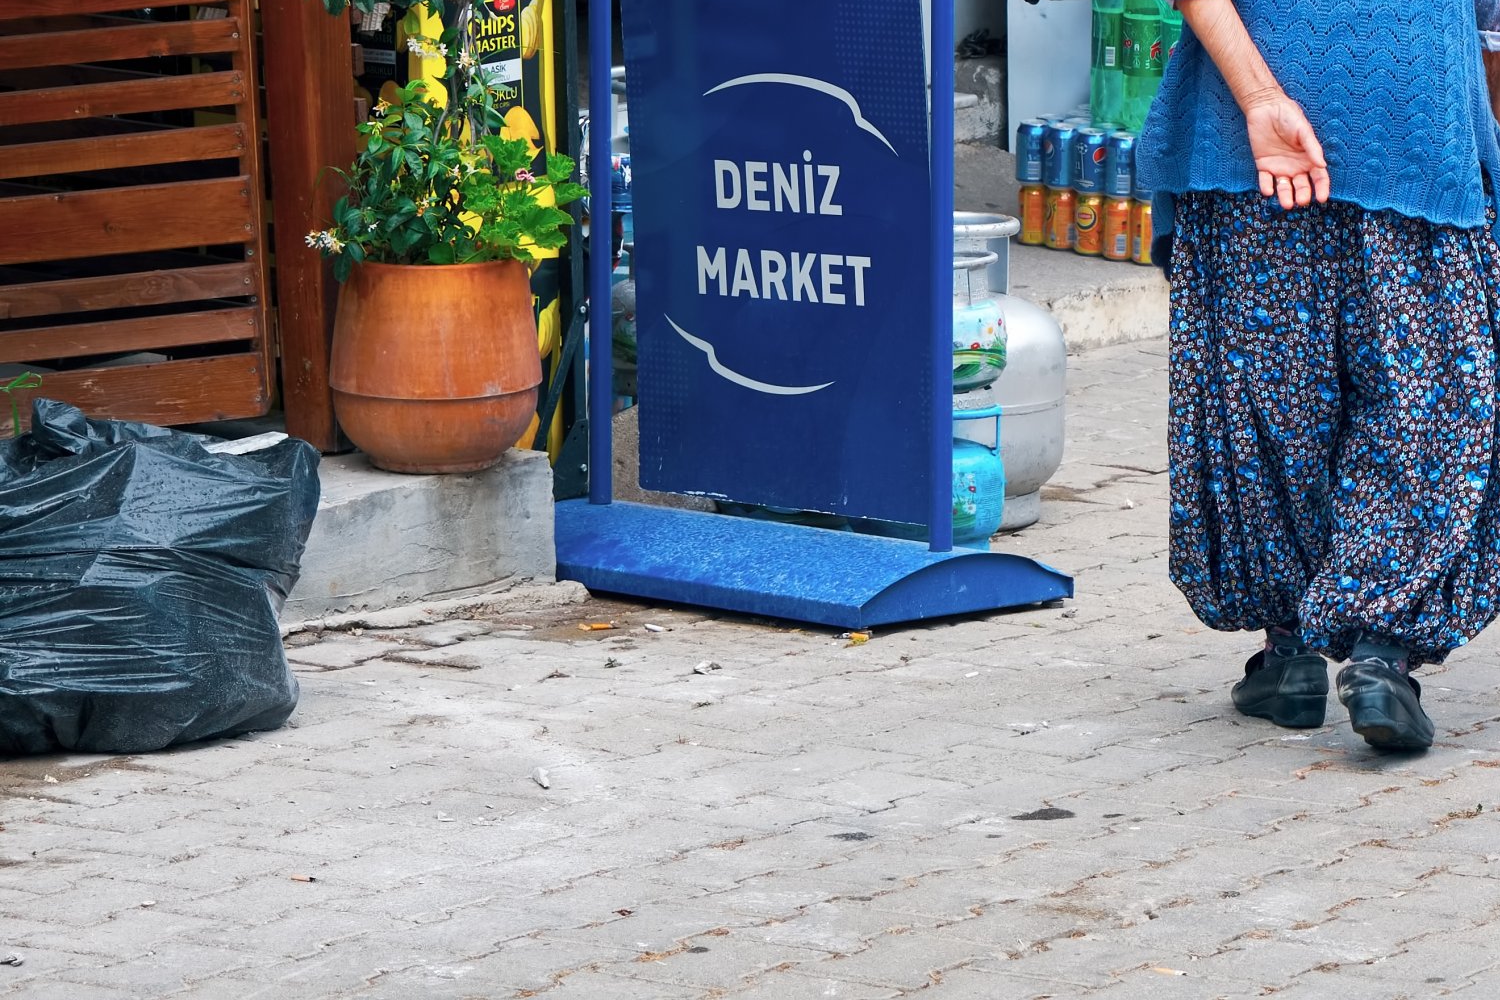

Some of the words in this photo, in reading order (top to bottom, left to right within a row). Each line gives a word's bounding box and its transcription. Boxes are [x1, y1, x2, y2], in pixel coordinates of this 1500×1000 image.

[467, 14, 516, 39] CHIPS
[714, 150, 843, 216] DENİZ
[697, 246, 871, 307] MARKET
